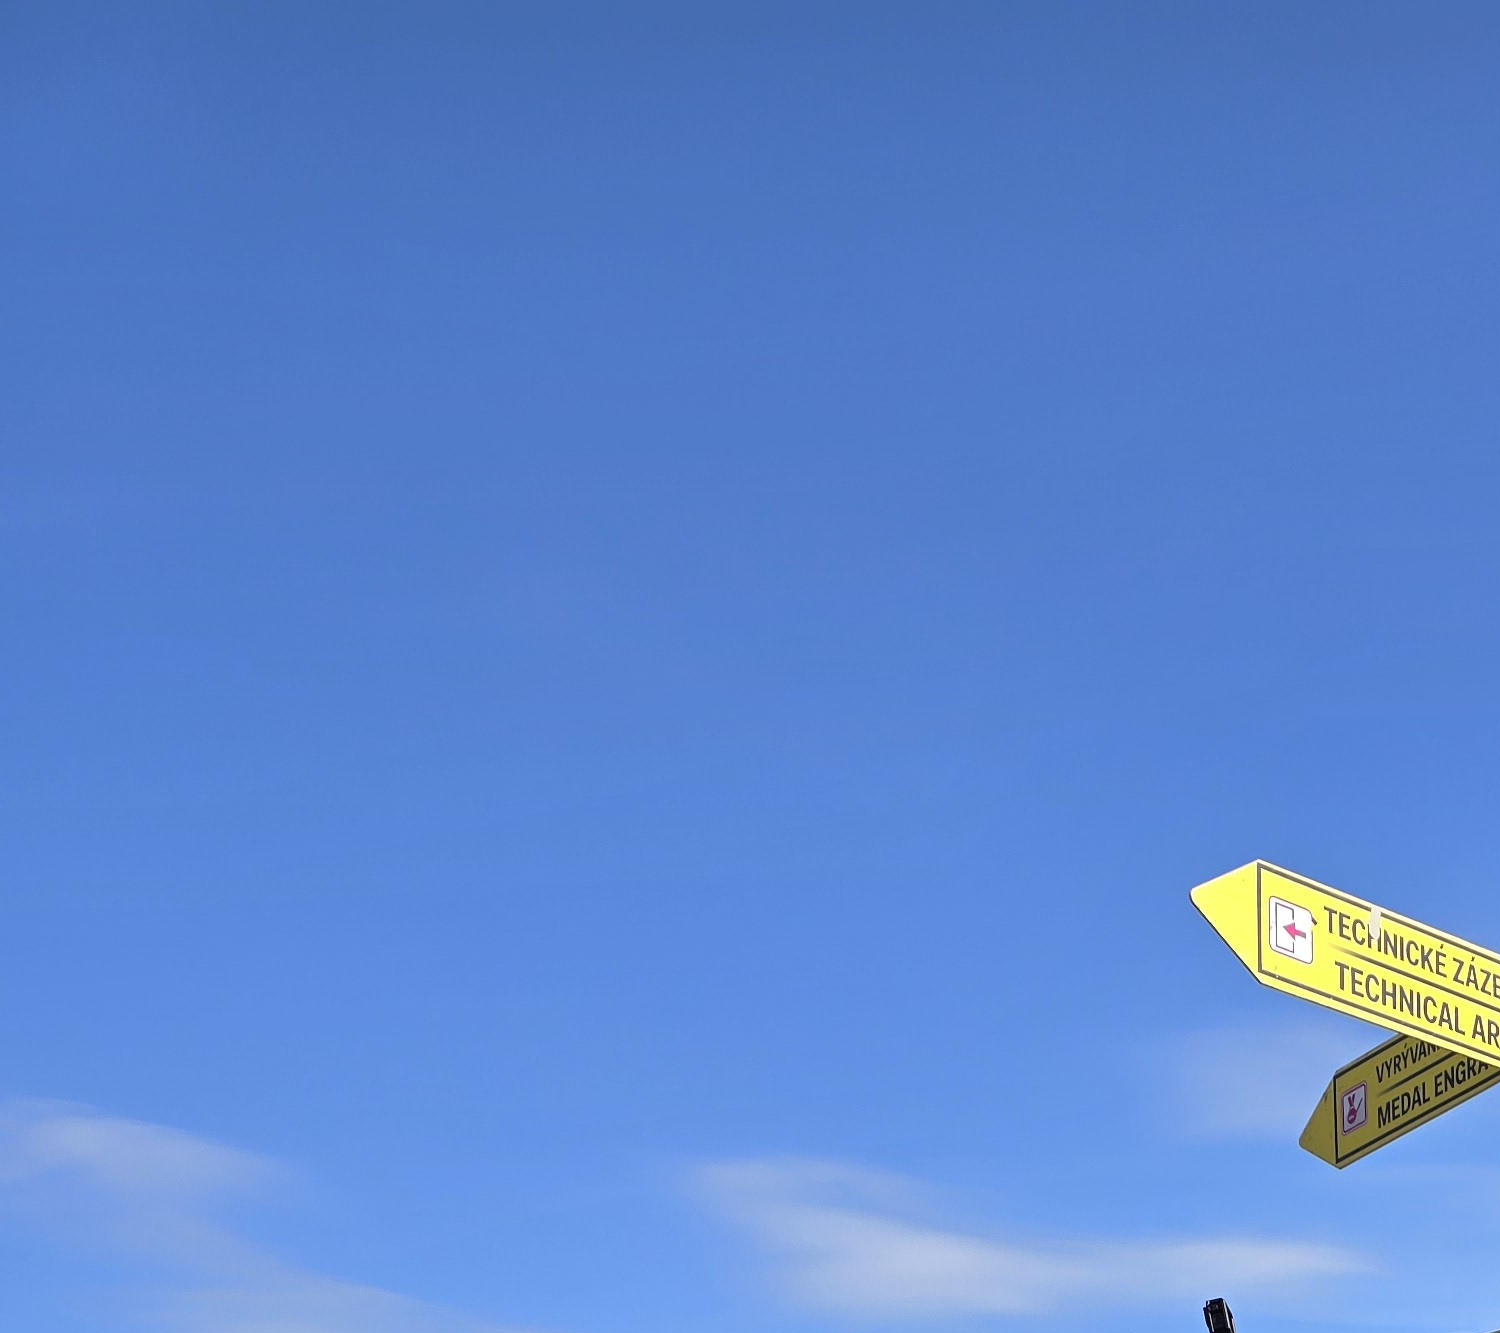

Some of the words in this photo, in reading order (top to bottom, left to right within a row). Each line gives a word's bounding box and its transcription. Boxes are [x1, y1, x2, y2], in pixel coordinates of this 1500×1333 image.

[1324, 905, 1448, 978] TECHNICKÉ
[1335, 960, 1466, 1036] TECHNICAL
[1377, 1083, 1431, 1129] MEDAL
[1434, 1055, 1490, 1098] ENGRA
